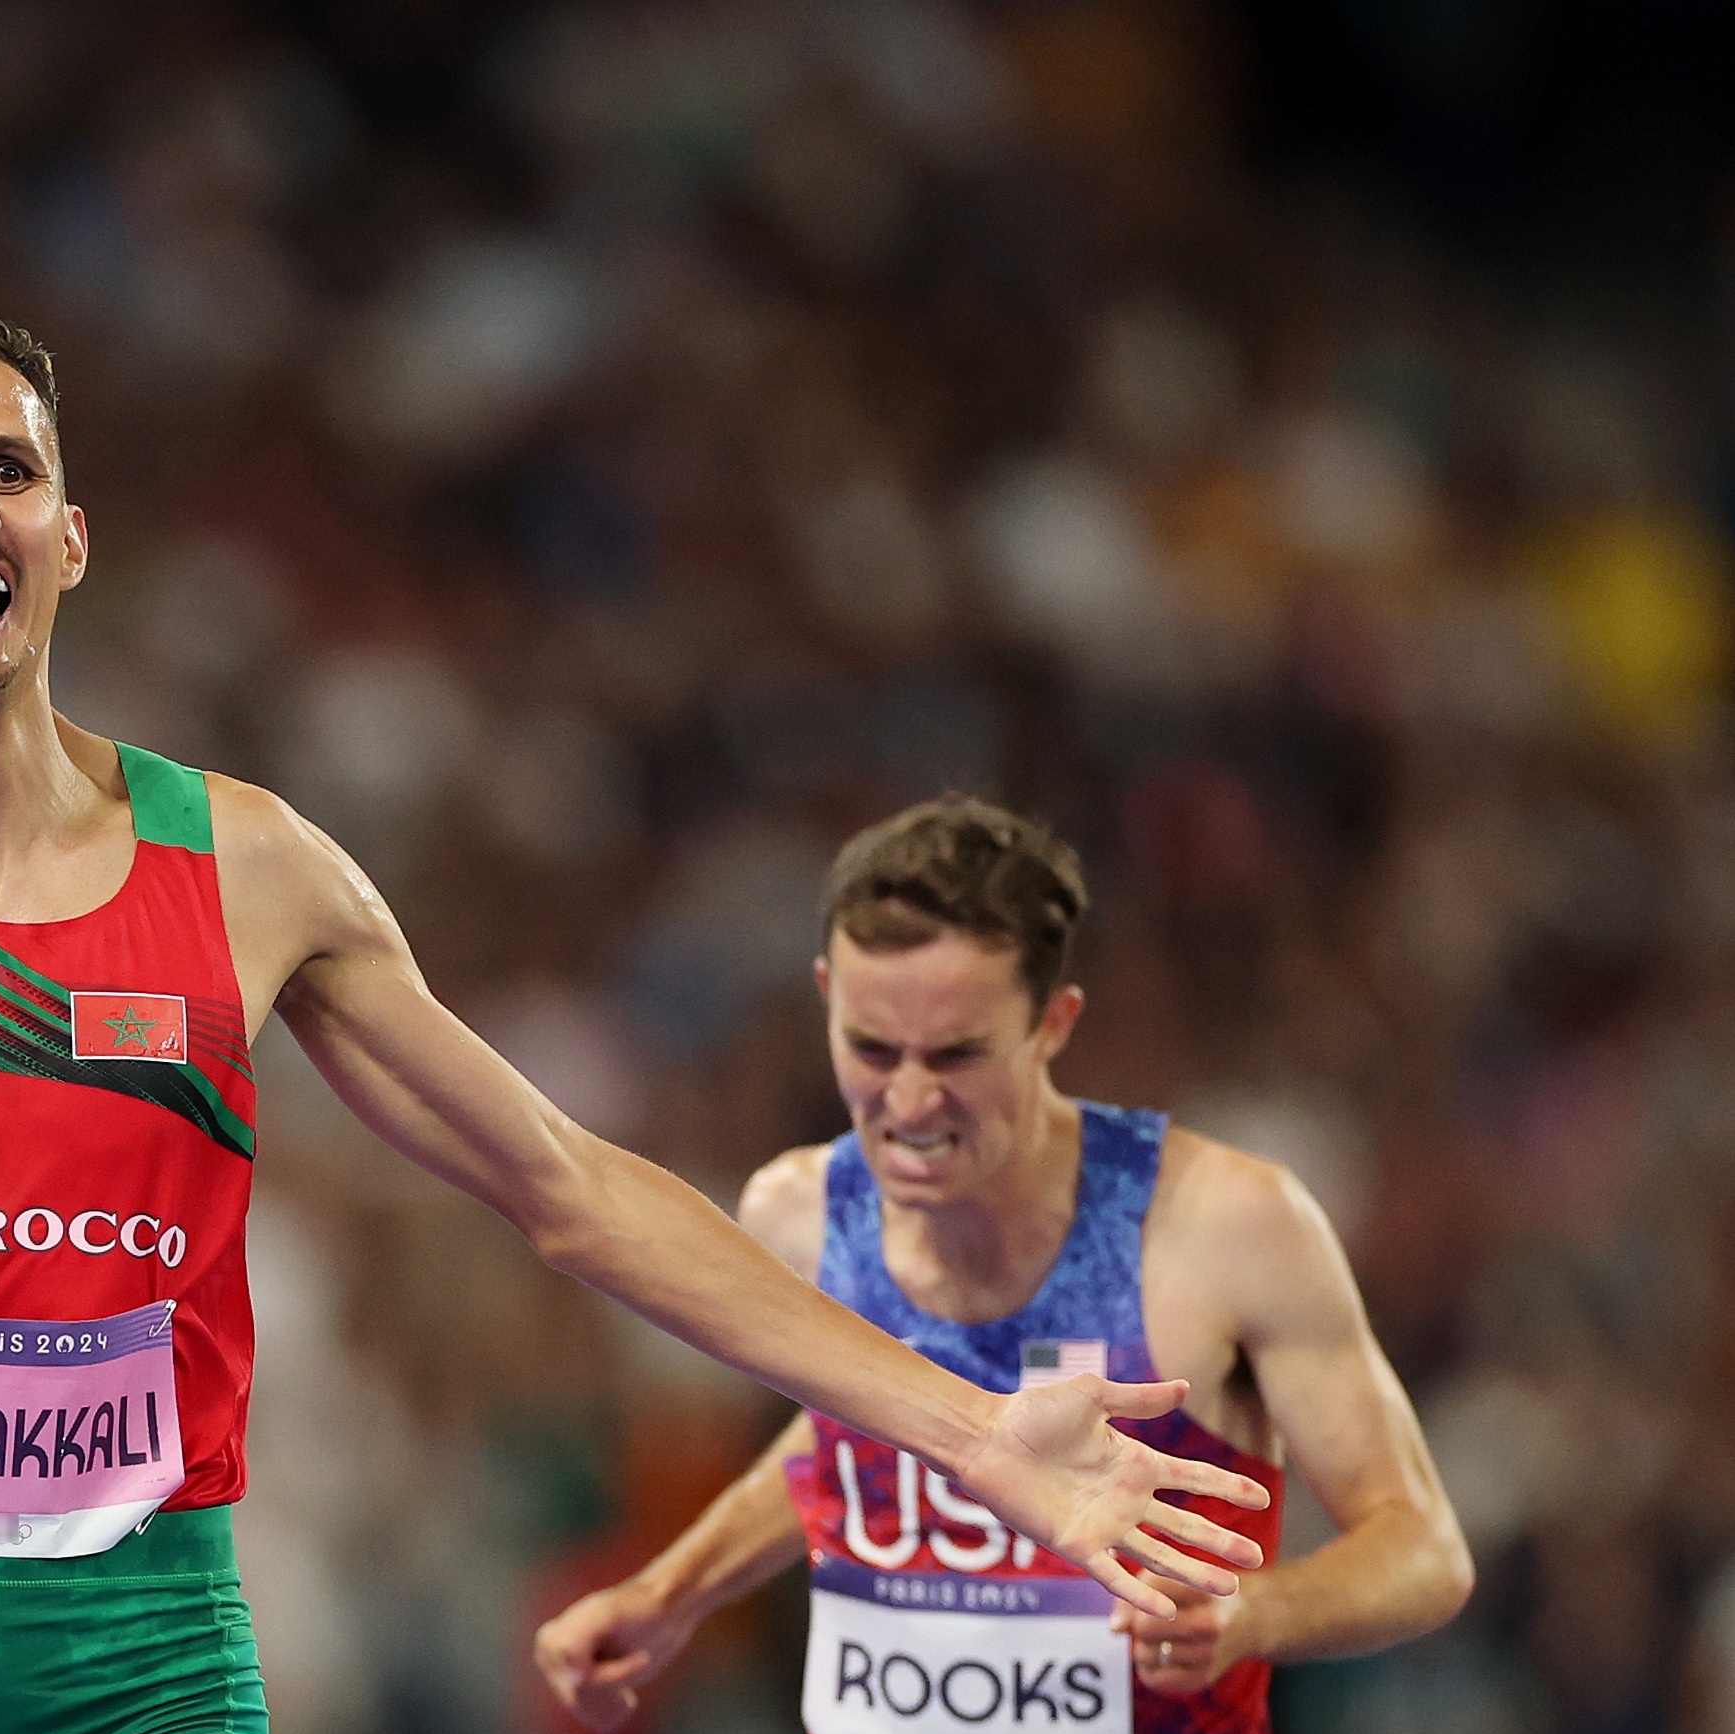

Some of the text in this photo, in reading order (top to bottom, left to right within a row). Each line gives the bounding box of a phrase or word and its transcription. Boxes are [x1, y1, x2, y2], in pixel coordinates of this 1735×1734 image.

[35, 1333, 109, 1355] 2024
[836, 1440, 1038, 1571] US
[836, 1639, 1105, 1723] ROOKS
